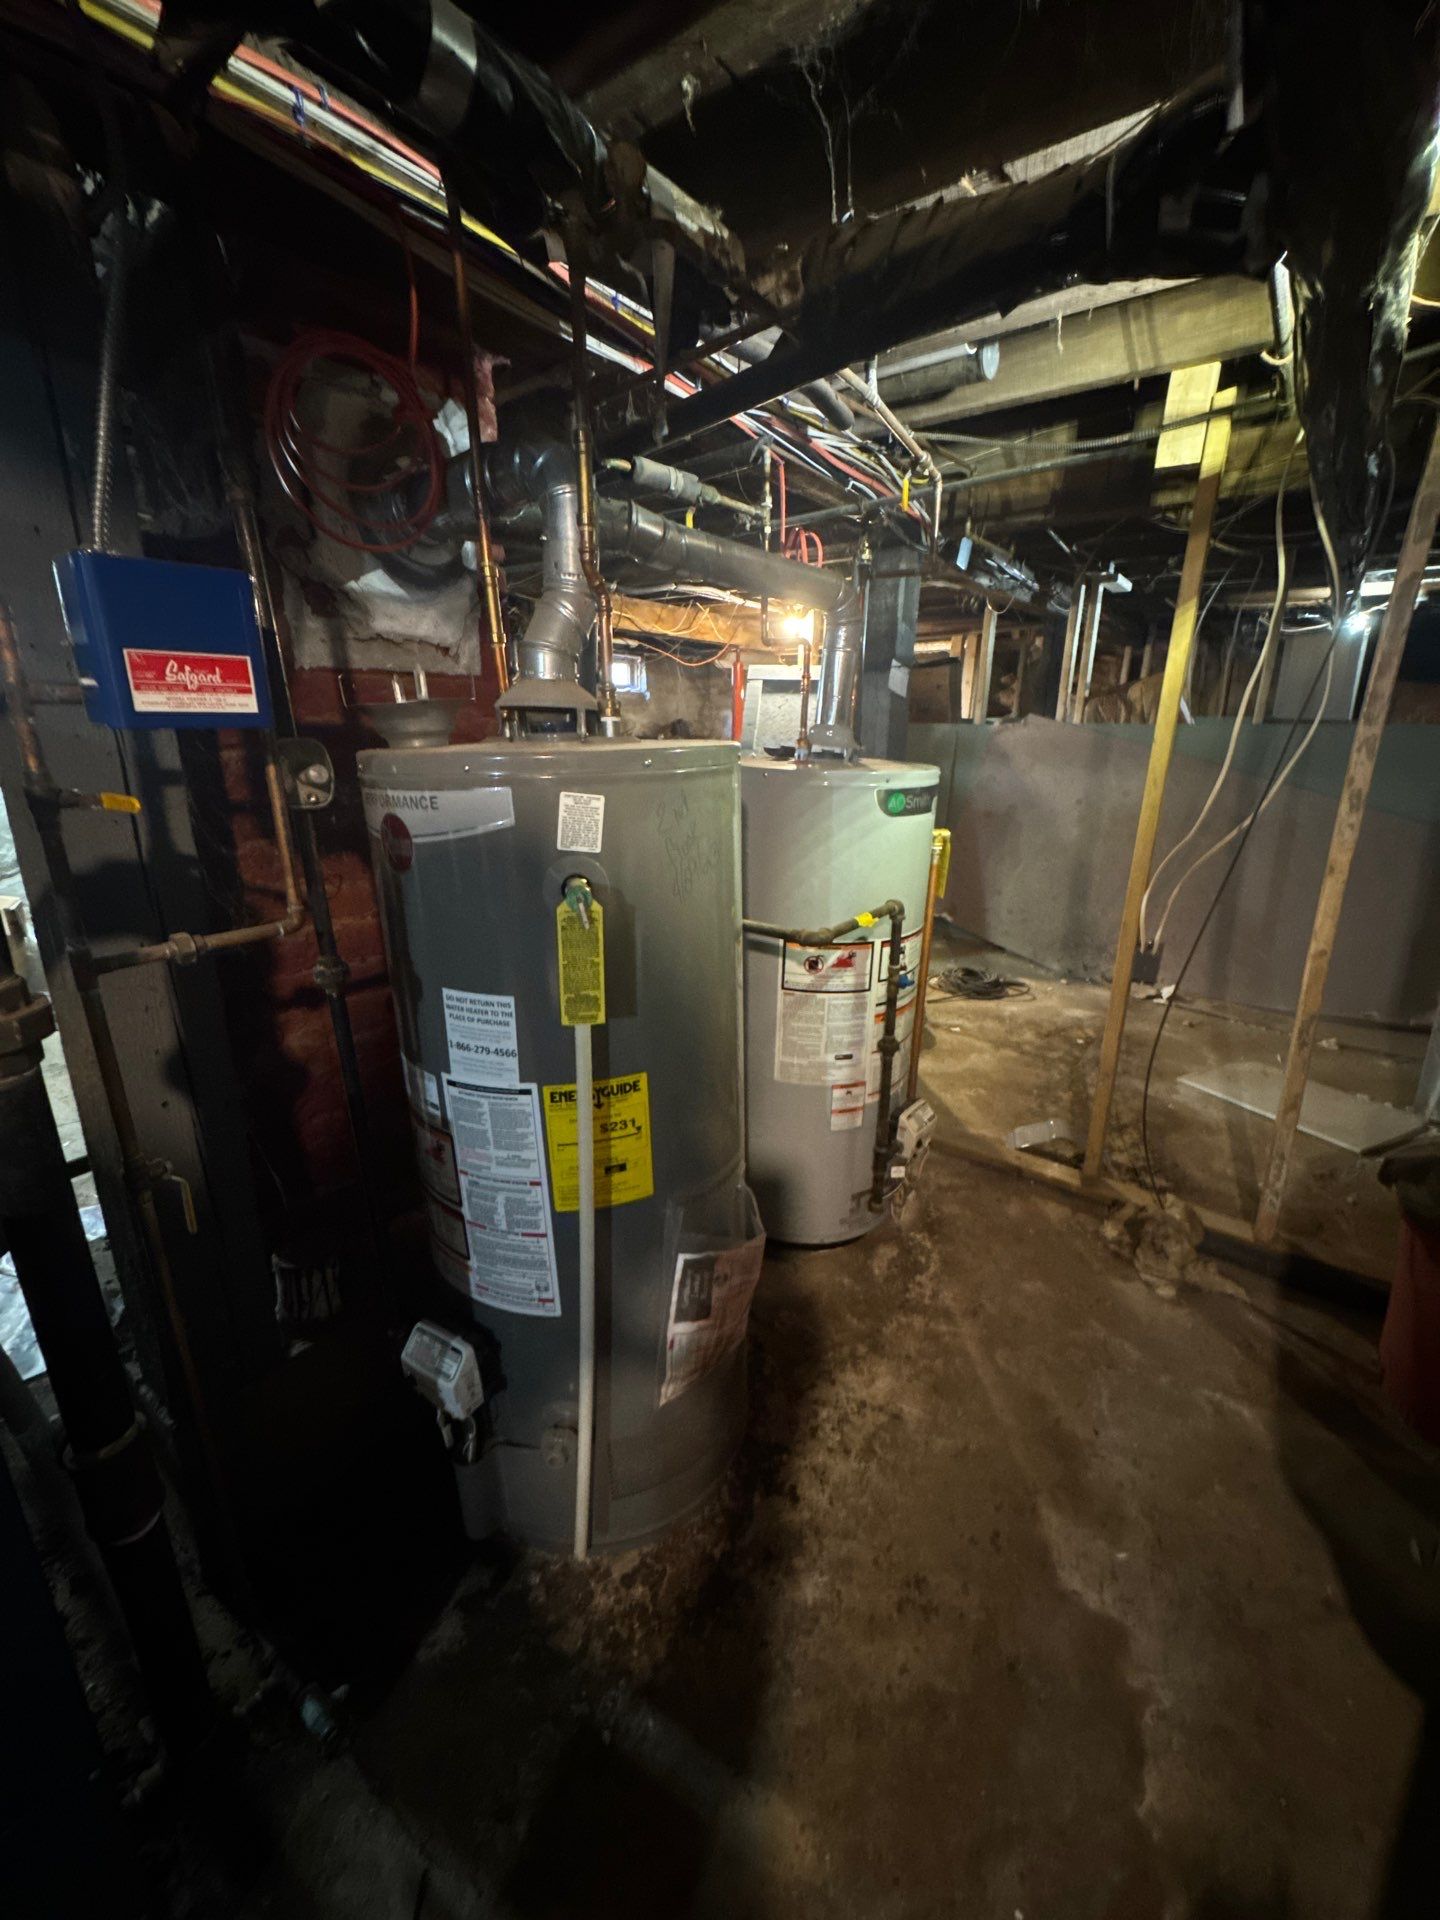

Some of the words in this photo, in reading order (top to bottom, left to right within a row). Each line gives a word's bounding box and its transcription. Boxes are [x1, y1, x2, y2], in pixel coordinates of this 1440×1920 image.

[165, 659, 223, 691] Safgard
[455, 996, 468, 1004] NOT
[469, 999, 495, 1007] RETURN
[445, 1003, 464, 1011] WATER
[465, 1006, 489, 1016] HEATER
[449, 1013, 466, 1021] PLACE
[476, 1018, 510, 1027] PURCHASE
[448, 1040, 518, 1058] 1-866-279-4566
[549, 1080, 641, 1104] ENEYGUIDE
[599, 1118, 637, 1133] $231
